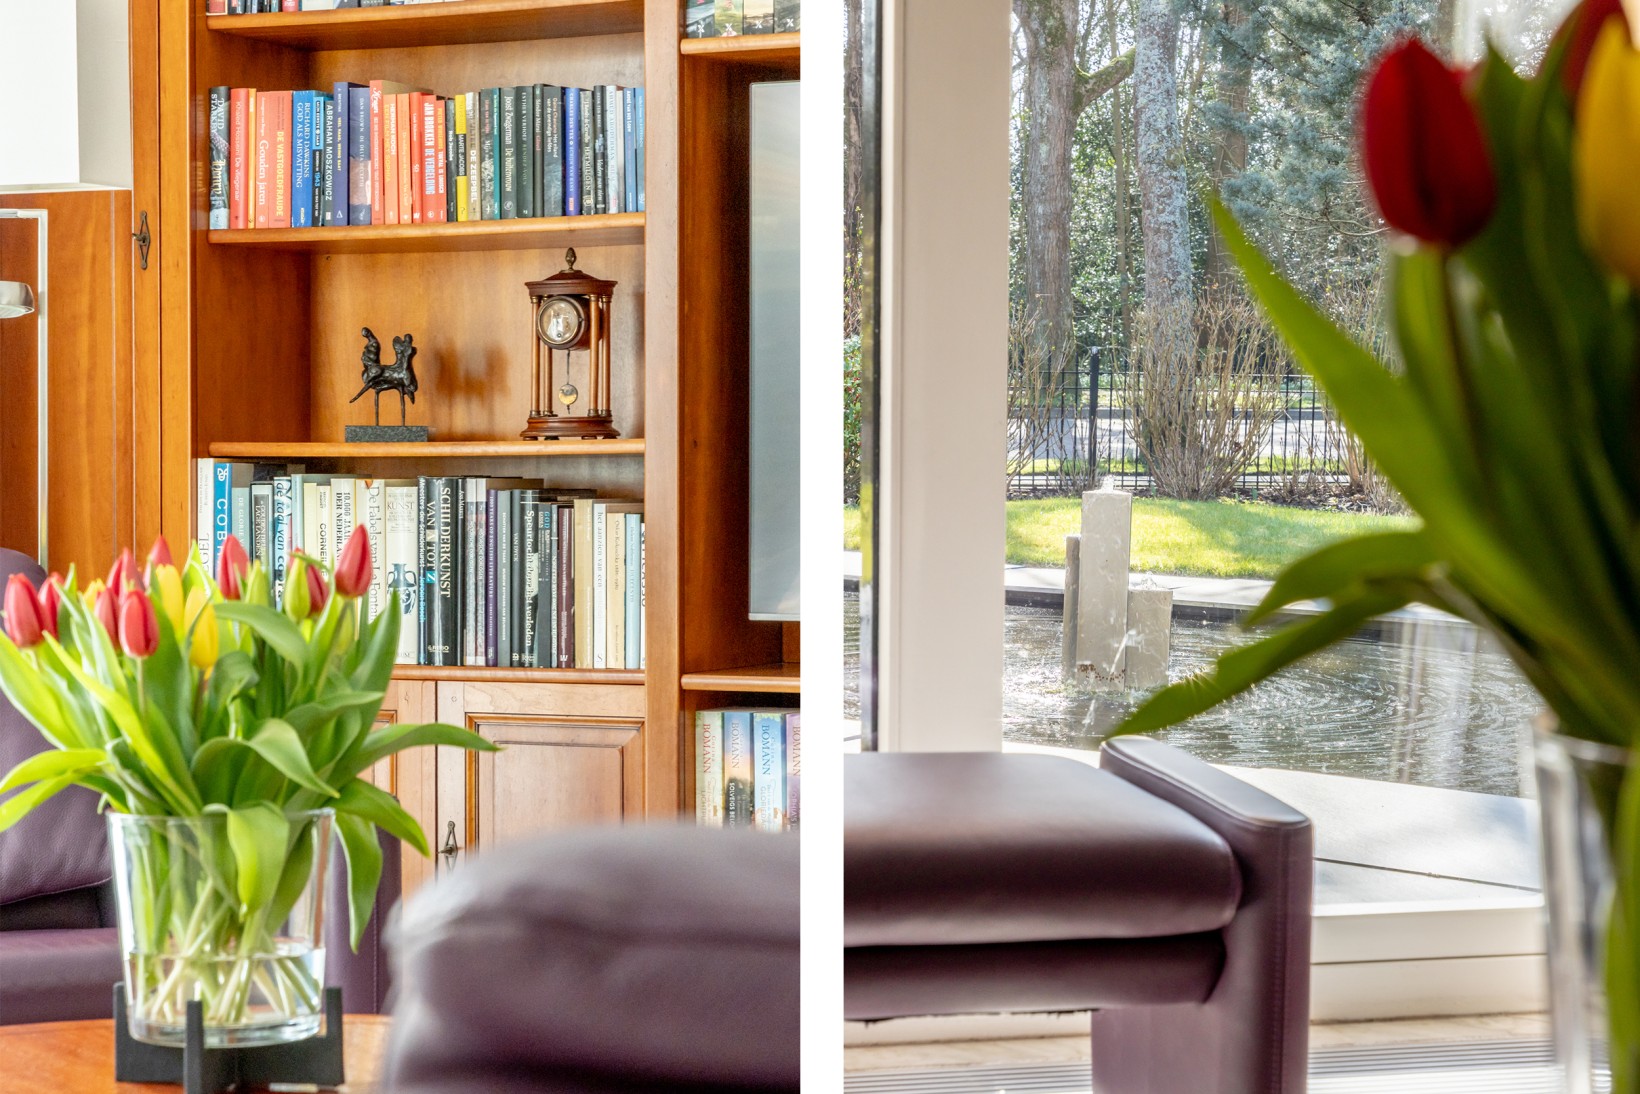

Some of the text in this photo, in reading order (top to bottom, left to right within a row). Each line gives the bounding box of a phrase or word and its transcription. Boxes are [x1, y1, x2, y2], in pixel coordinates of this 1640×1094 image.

[506, 96, 514, 110] Joost
[276, 131, 284, 142] DE
[504, 112, 514, 144] Zwagerman
[424, 102, 435, 195] JAN BROKKEN DE VERGELDING
[470, 150, 477, 162] DE
[234, 158, 240, 166] De
[257, 140, 269, 205] Gouden jaren
[506, 158, 514, 192] buitenvrouw
[276, 482, 286, 497] de
[370, 486, 380, 503] De
[238, 498, 244, 507] DE
[276, 502, 288, 525] taal
[387, 502, 415, 510] KUNST
[427, 501, 436, 526] VAN
[369, 505, 381, 540] Fabels
[277, 530, 285, 550] van
[440, 488, 450, 598] SCHILDERKUNST
[526, 510, 534, 561] Speurtocht
[427, 544, 436, 570] TOT
[427, 572, 436, 582] Z
[526, 605, 534, 647] verleden
[703, 724, 711, 774] BOMANN
[731, 722, 740, 769] BOMANN
[762, 725, 770, 776] BOMANN
